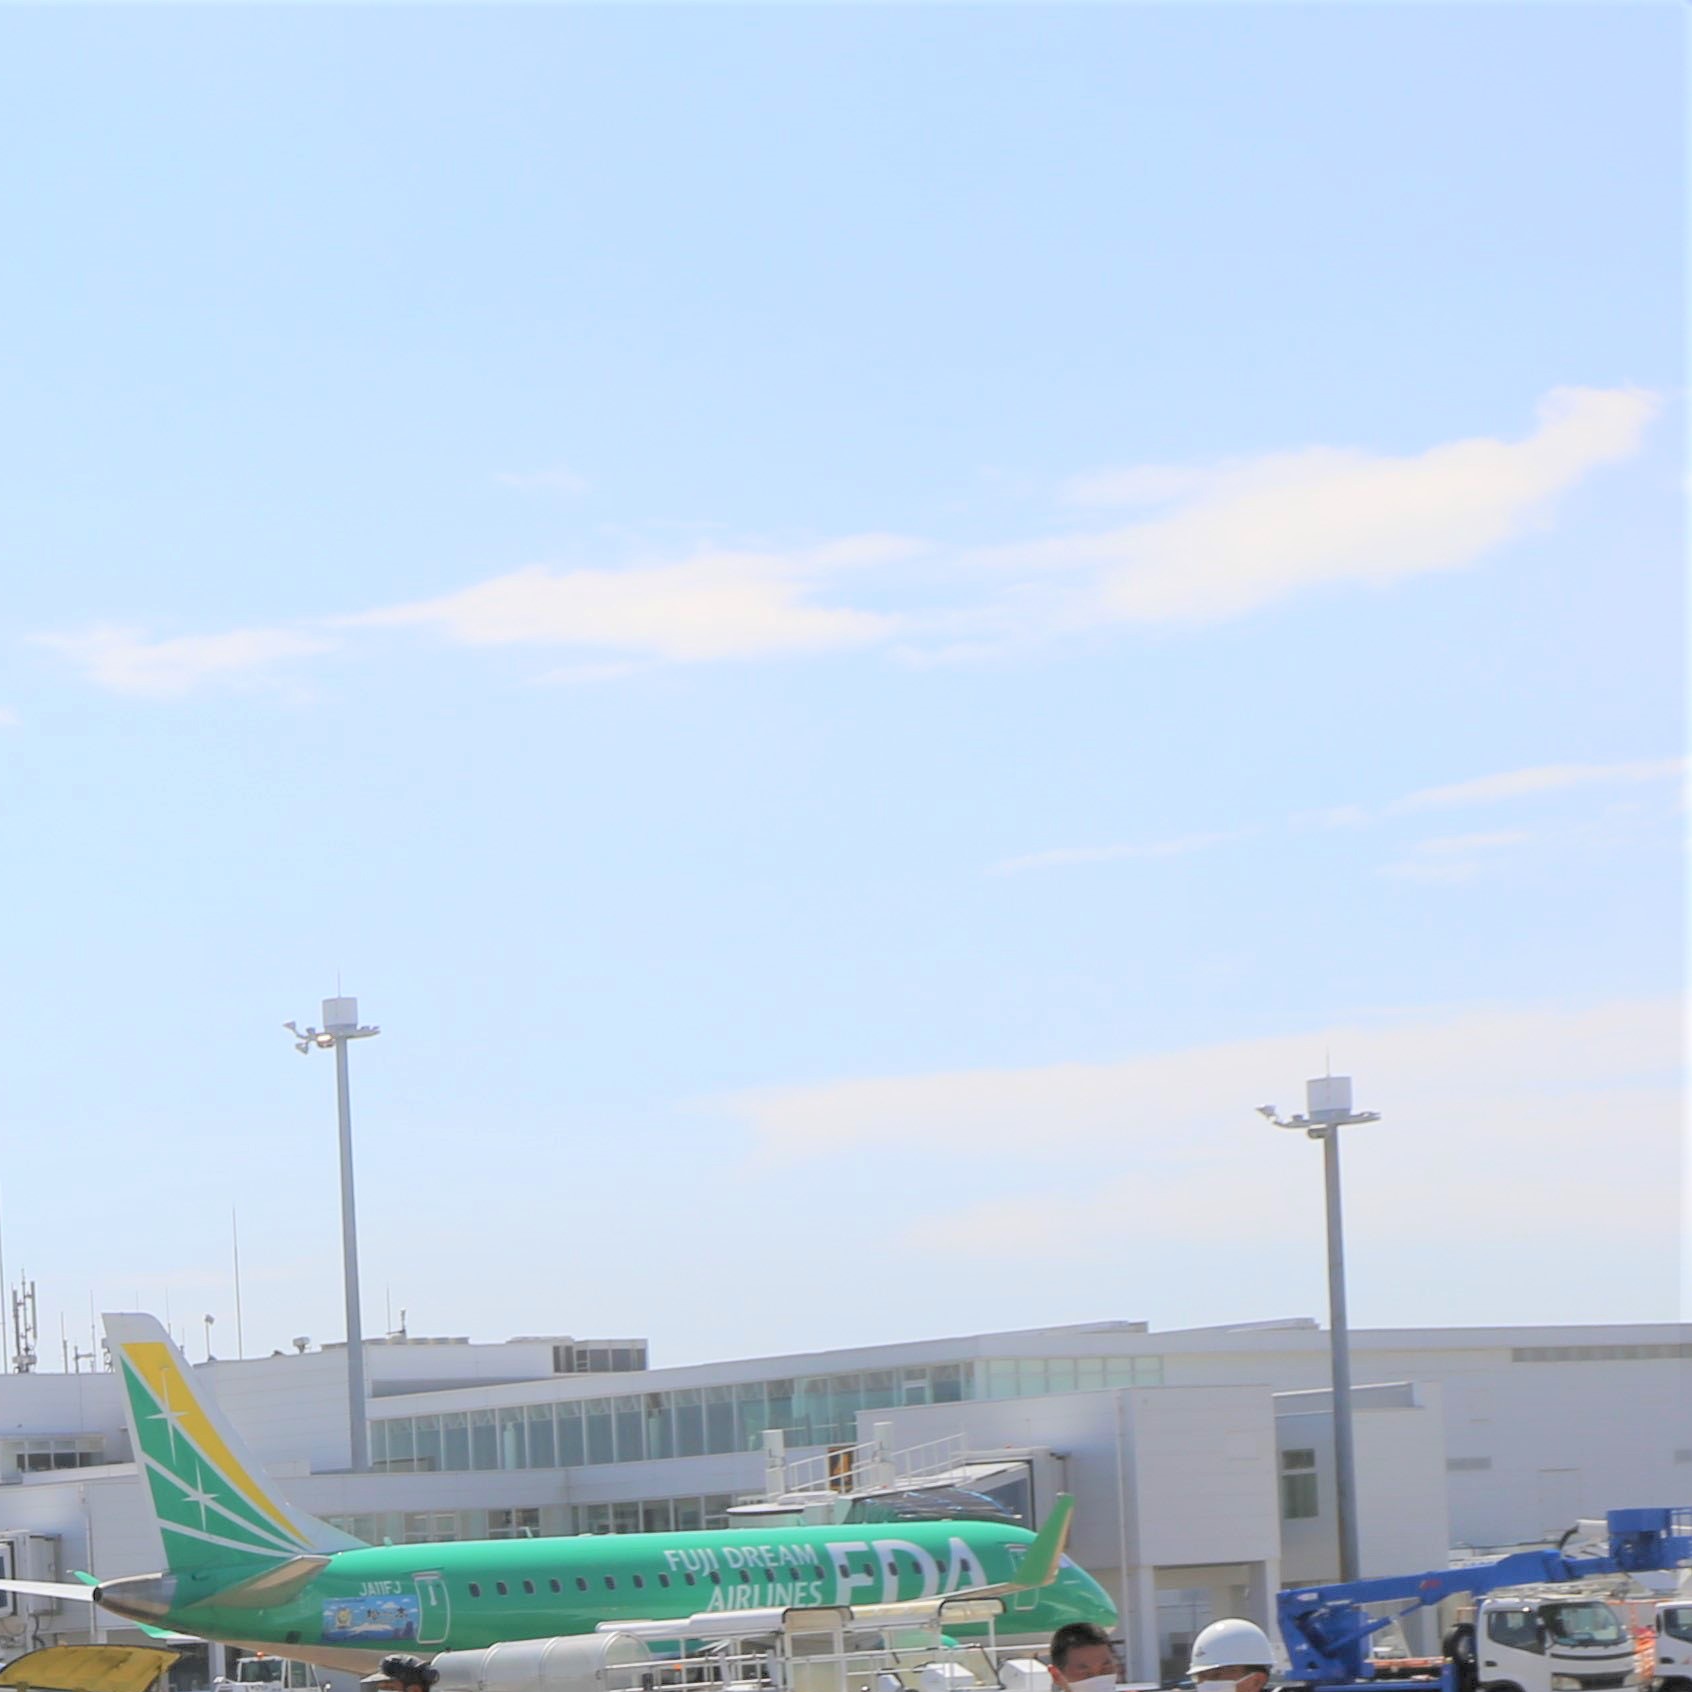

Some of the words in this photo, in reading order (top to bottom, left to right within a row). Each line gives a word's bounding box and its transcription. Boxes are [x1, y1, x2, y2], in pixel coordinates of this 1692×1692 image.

[663, 1549, 719, 1576] FUJI
[721, 1544, 819, 1569] DREAM
[824, 1537, 988, 1606] FDA
[359, 1580, 402, 1597] JA11FJ
[706, 1581, 824, 1613] AIRLINES
